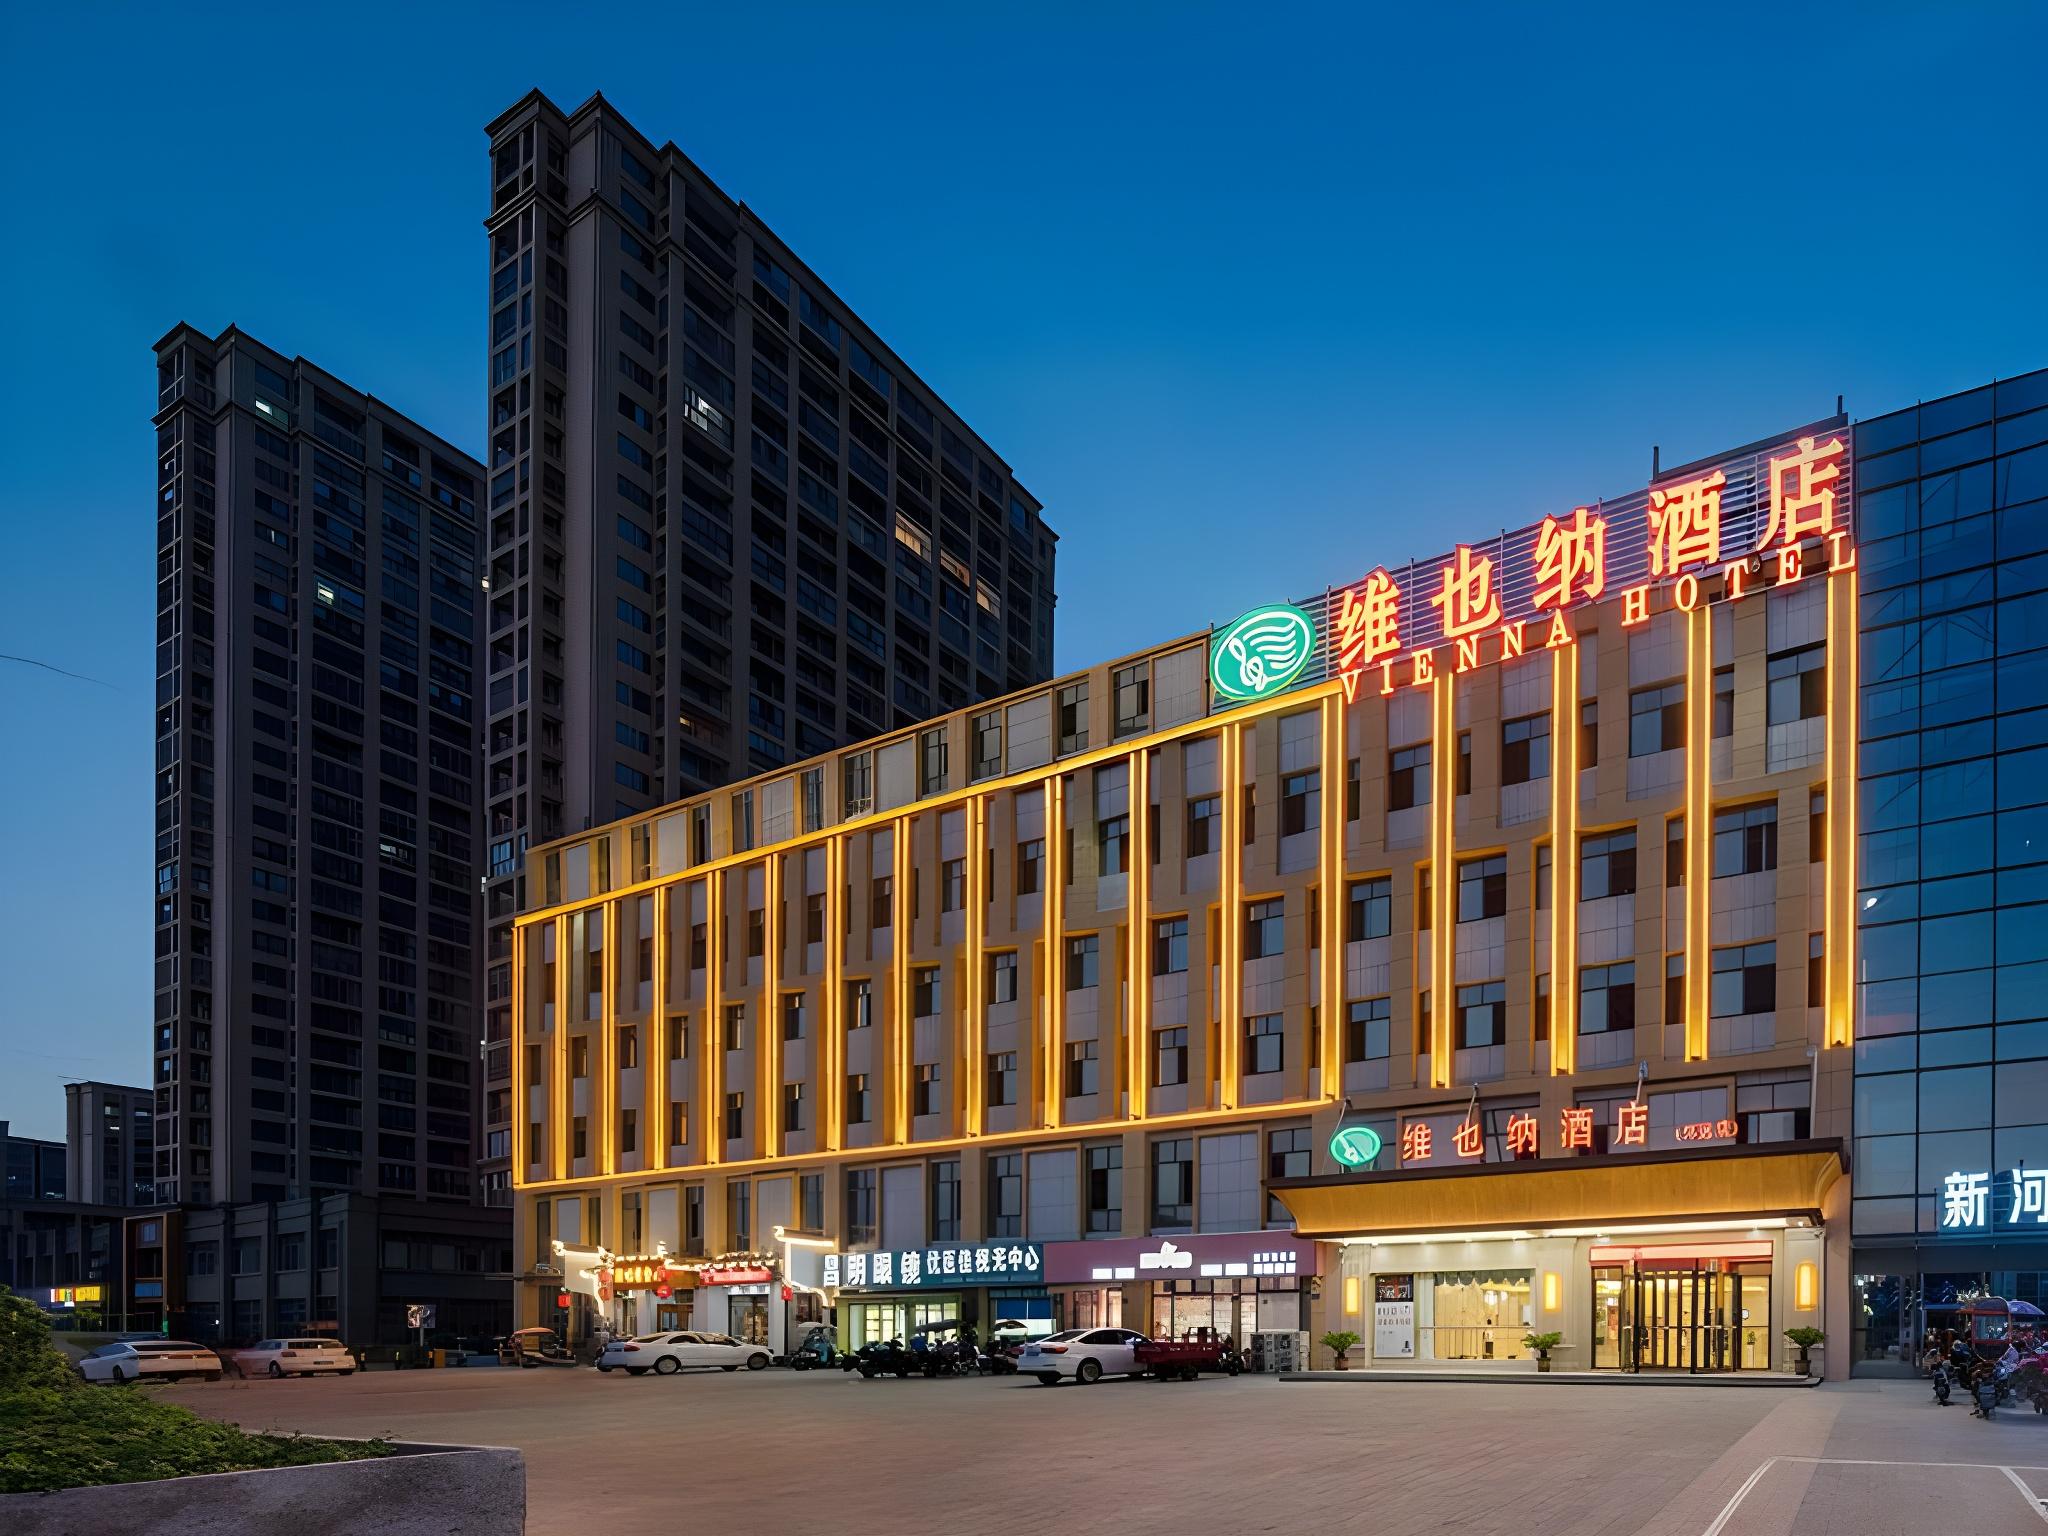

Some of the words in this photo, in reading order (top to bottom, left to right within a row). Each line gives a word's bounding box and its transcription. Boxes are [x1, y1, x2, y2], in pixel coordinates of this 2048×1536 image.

[1337, 437, 1844, 669] 维也纳酒店
[1339, 608, 1572, 704] VIENNA
[1621, 531, 1856, 627] HOTEL
[1402, 1102, 1648, 1160] 维也纳酒店
[1943, 1169, 2048, 1227] 新河
